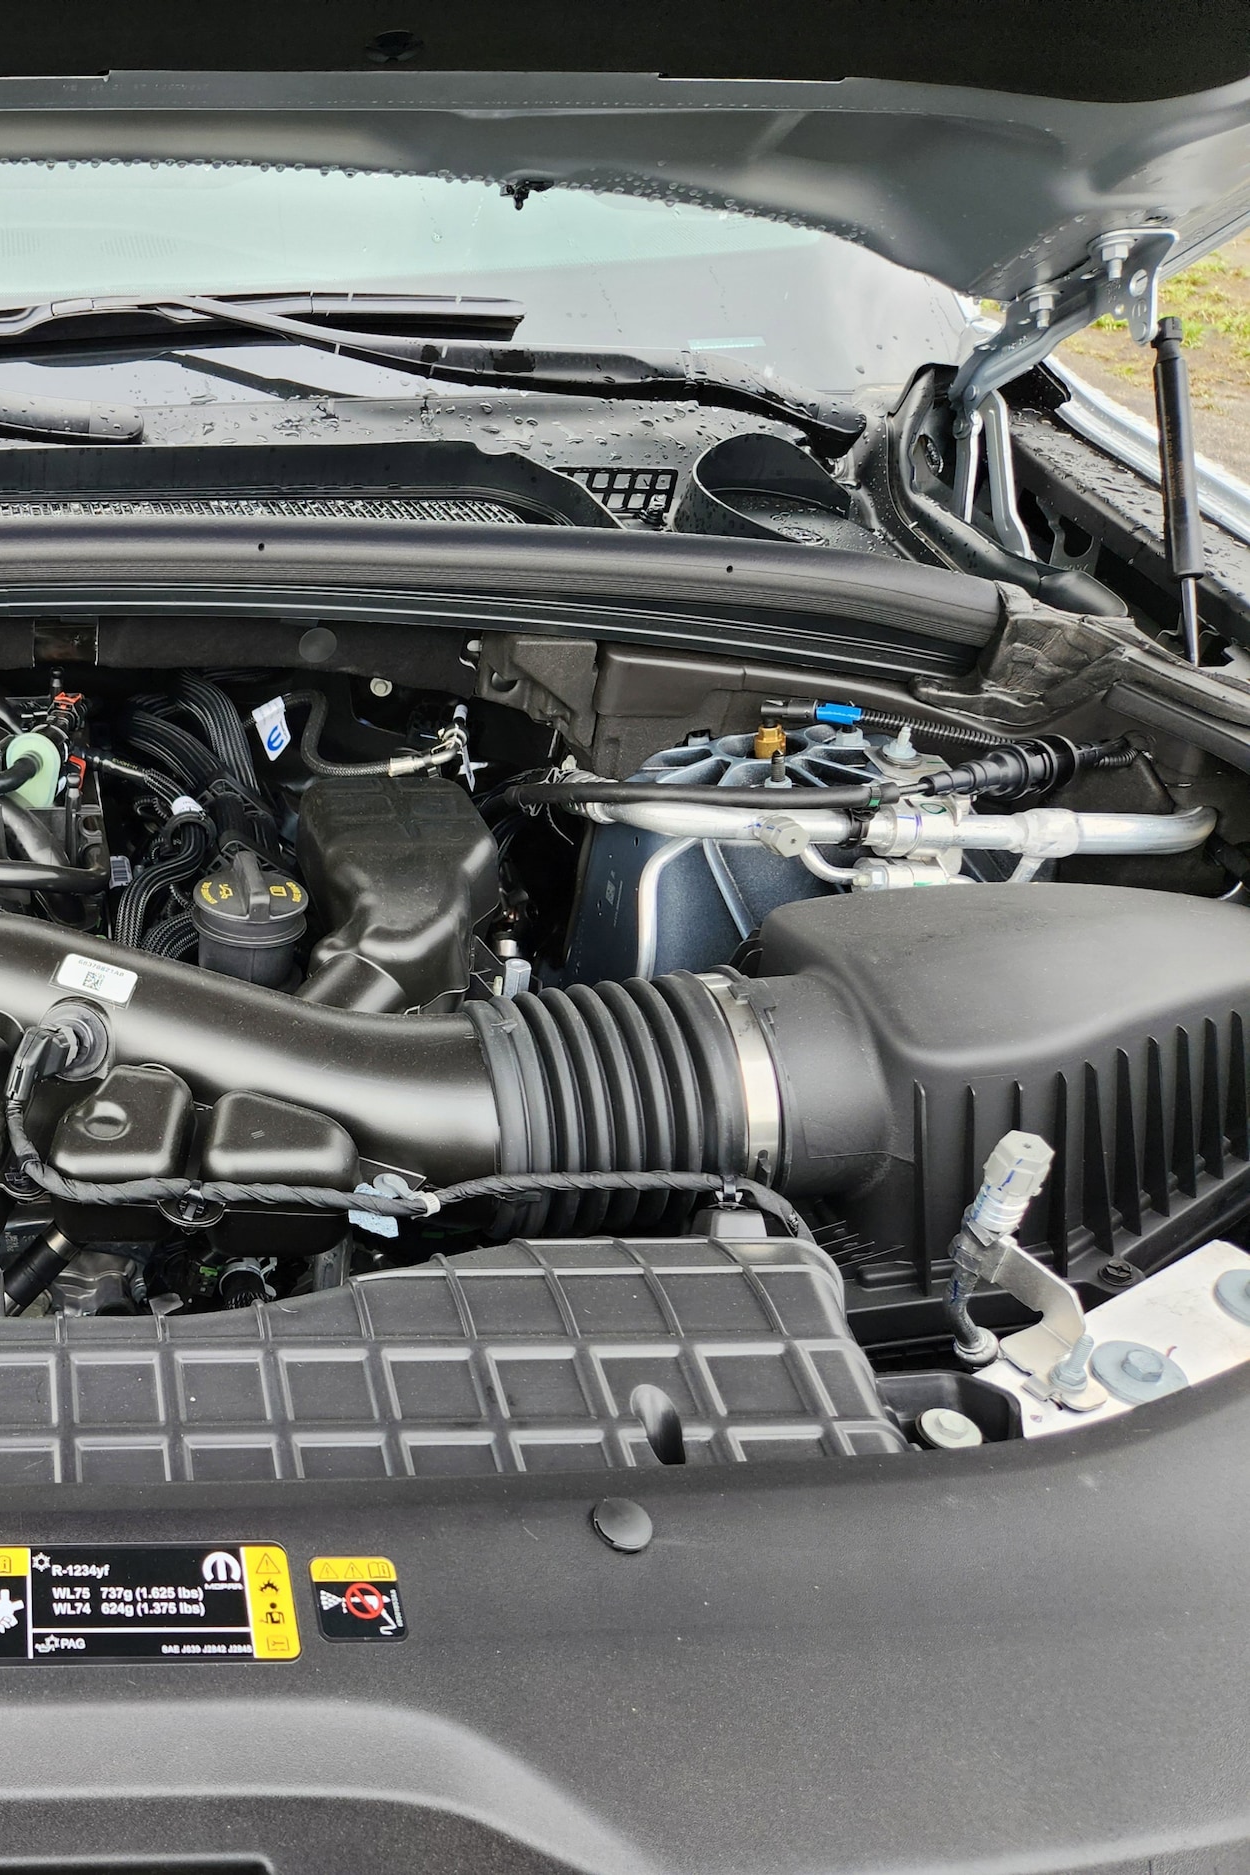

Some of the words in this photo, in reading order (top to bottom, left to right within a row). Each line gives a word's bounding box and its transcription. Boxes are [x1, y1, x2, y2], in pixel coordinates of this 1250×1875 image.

[51, 1563, 110, 1579] R-1234yf
[52, 1587, 91, 1599] WL75
[100, 1587, 133, 1601] 737g
[135, 1586, 176, 1602] (1.625
[177, 1586, 204, 1602] lbs)
[53, 1602, 92, 1615] WL74
[101, 1602, 135, 1617] 624g
[136, 1602, 177, 1617] (1.375
[178, 1601, 206, 1617] lbs)
[60, 1637, 87, 1650] PAG
